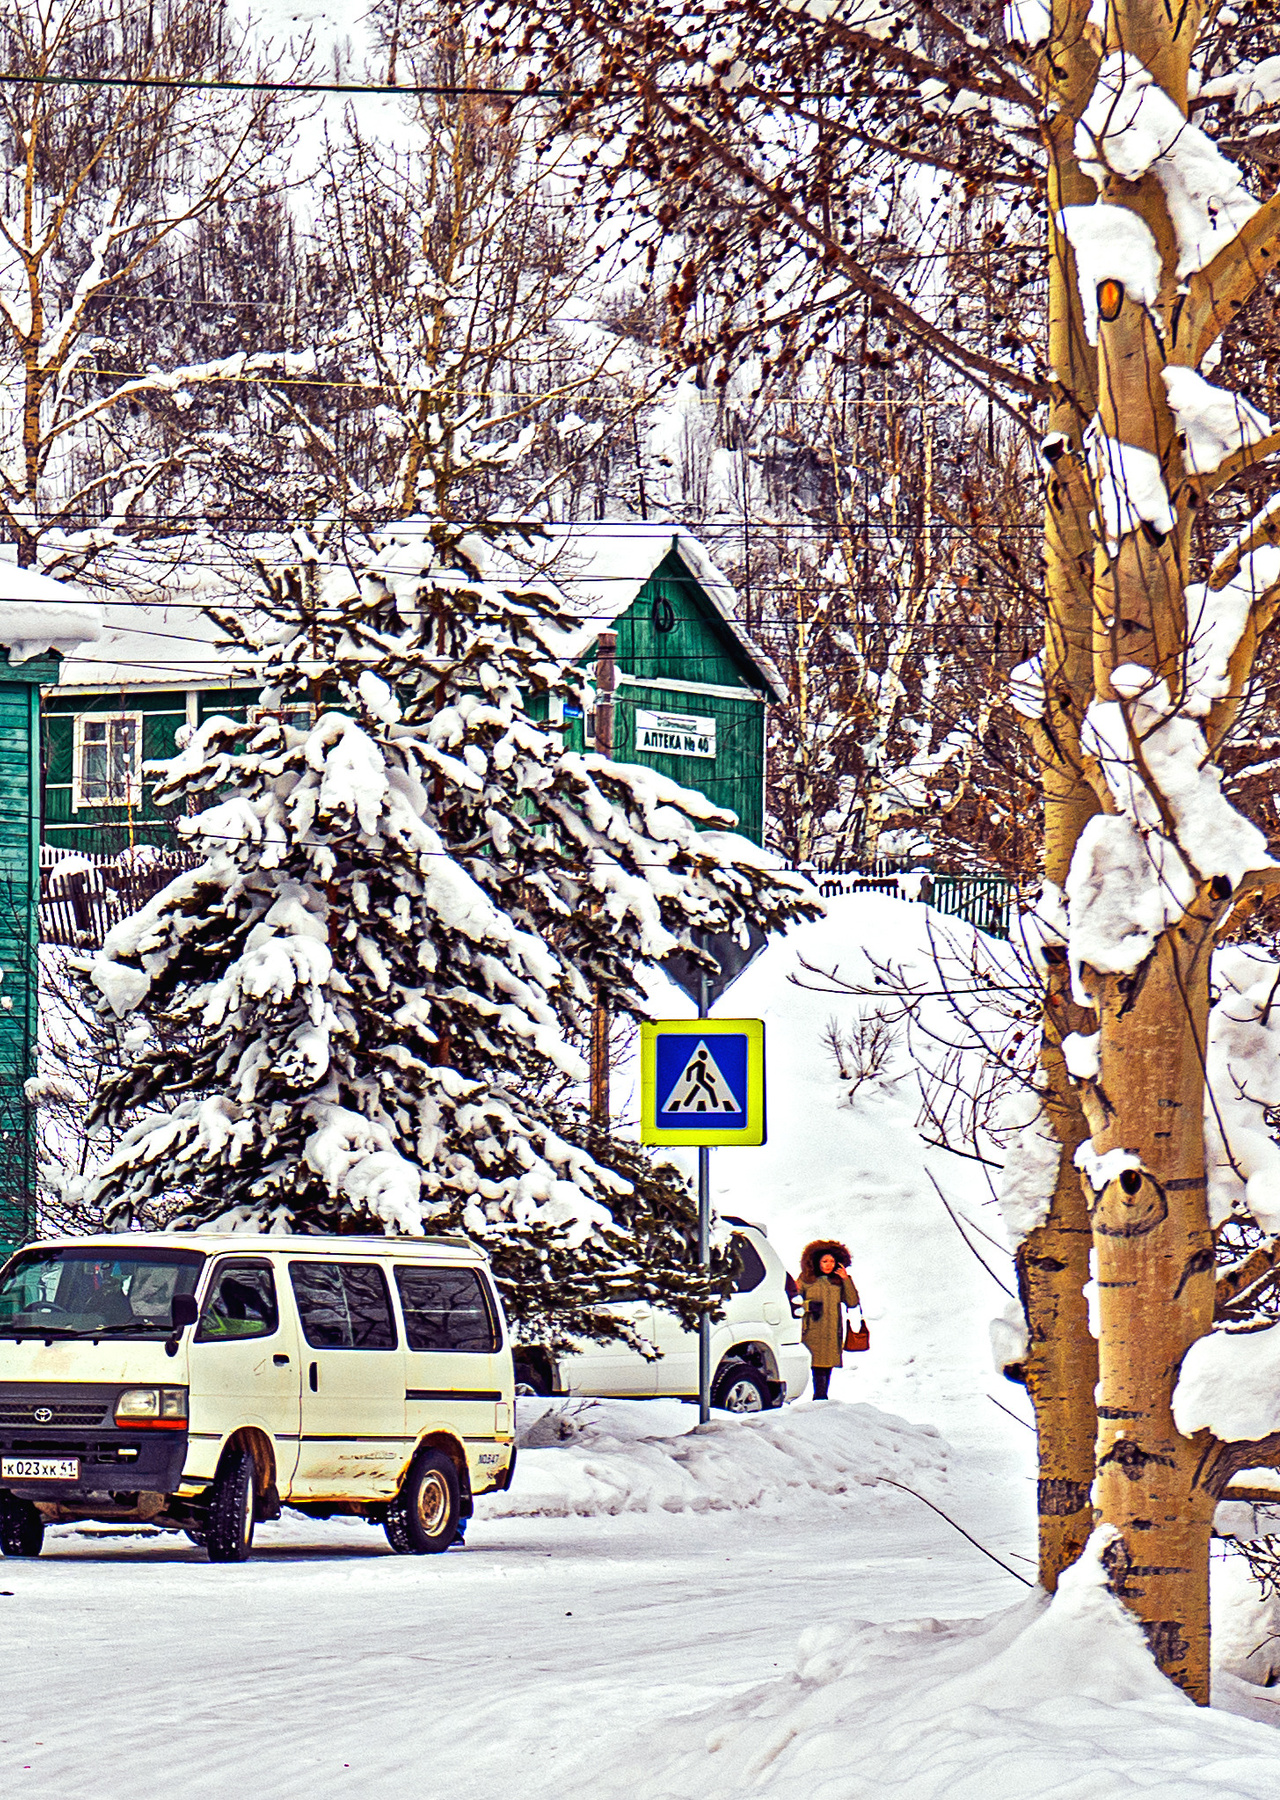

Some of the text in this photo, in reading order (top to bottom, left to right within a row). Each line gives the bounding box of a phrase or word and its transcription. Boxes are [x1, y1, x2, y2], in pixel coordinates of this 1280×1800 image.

[643, 731, 709, 753] АПТЕКА № 40
